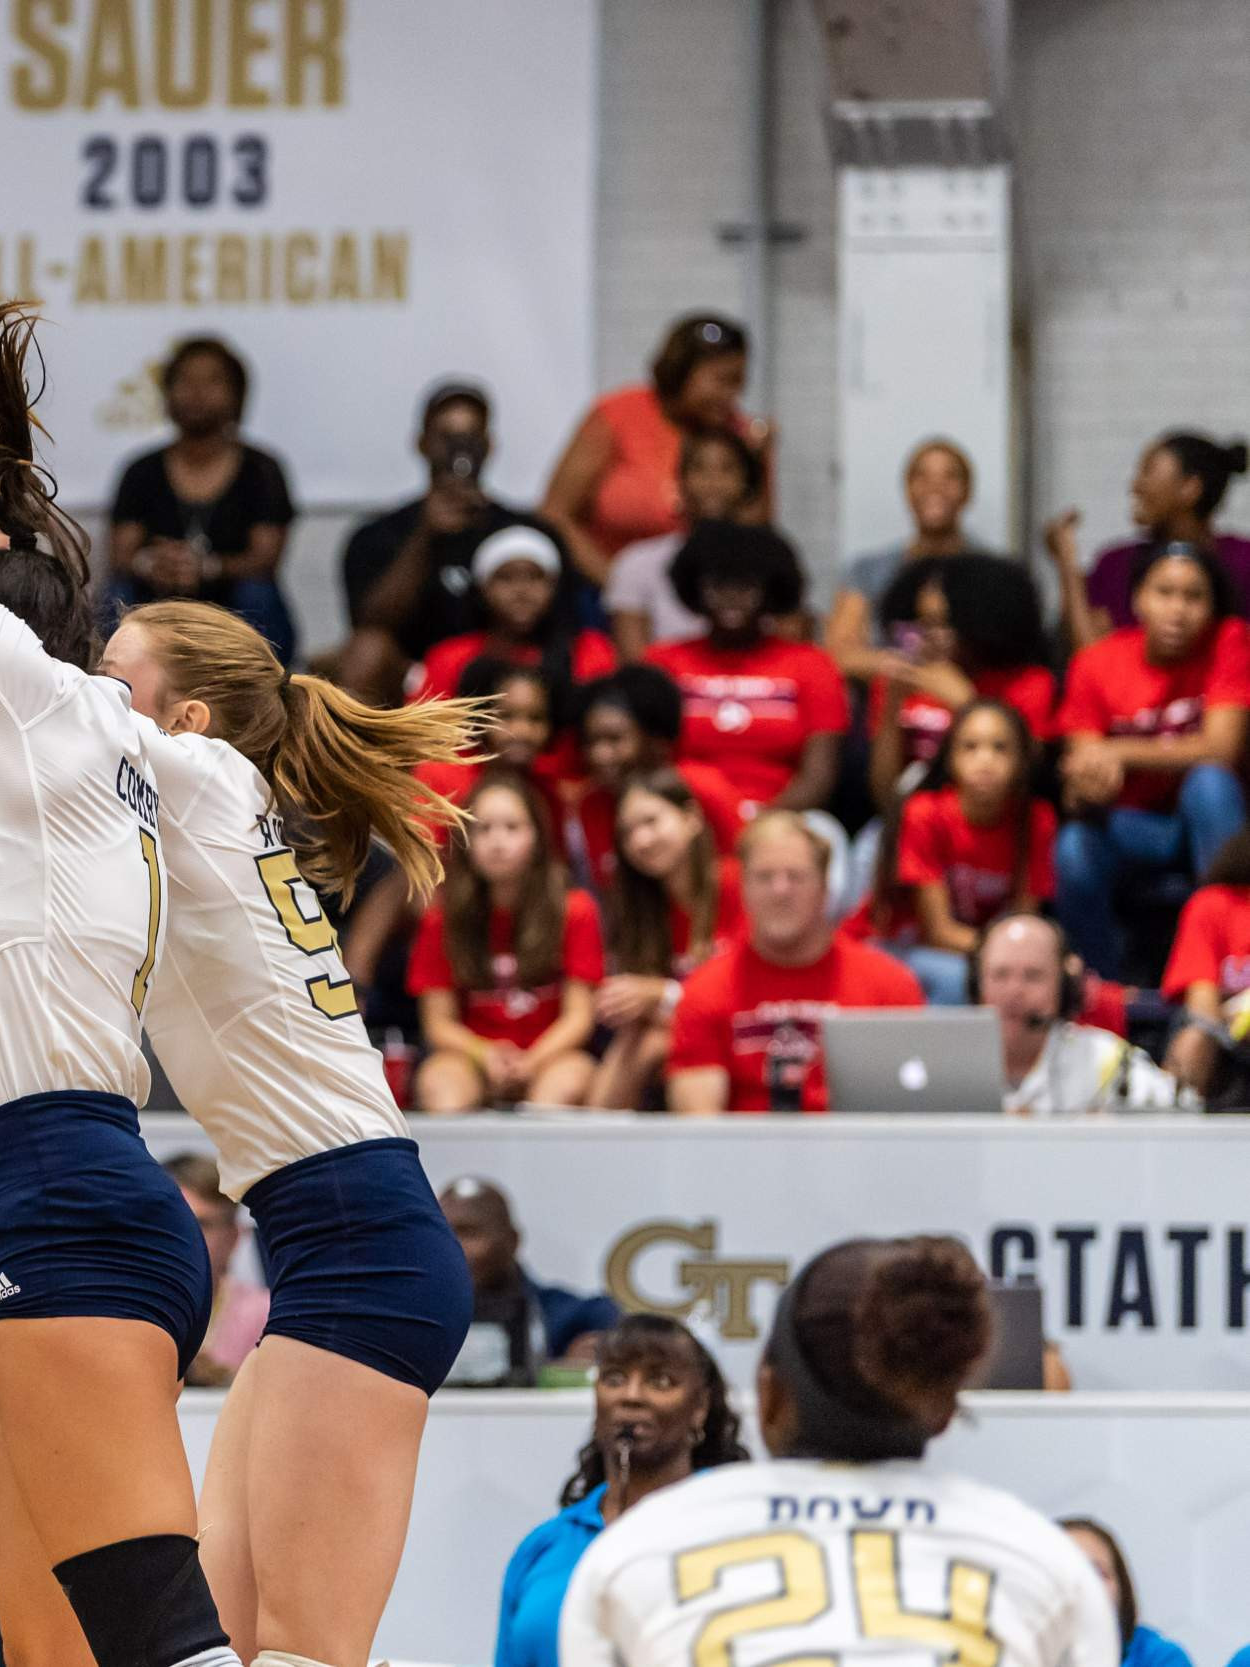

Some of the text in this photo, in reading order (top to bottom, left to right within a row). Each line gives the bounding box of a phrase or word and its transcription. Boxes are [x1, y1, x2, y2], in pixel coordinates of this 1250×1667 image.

[10, 0, 347, 112] SAUER
[81, 133, 269, 209] 2003
[131, 825, 161, 1020] 1
[253, 848, 358, 1021] 9
[606, 1220, 789, 1339] GT
[673, 1525, 1004, 1667] 24
